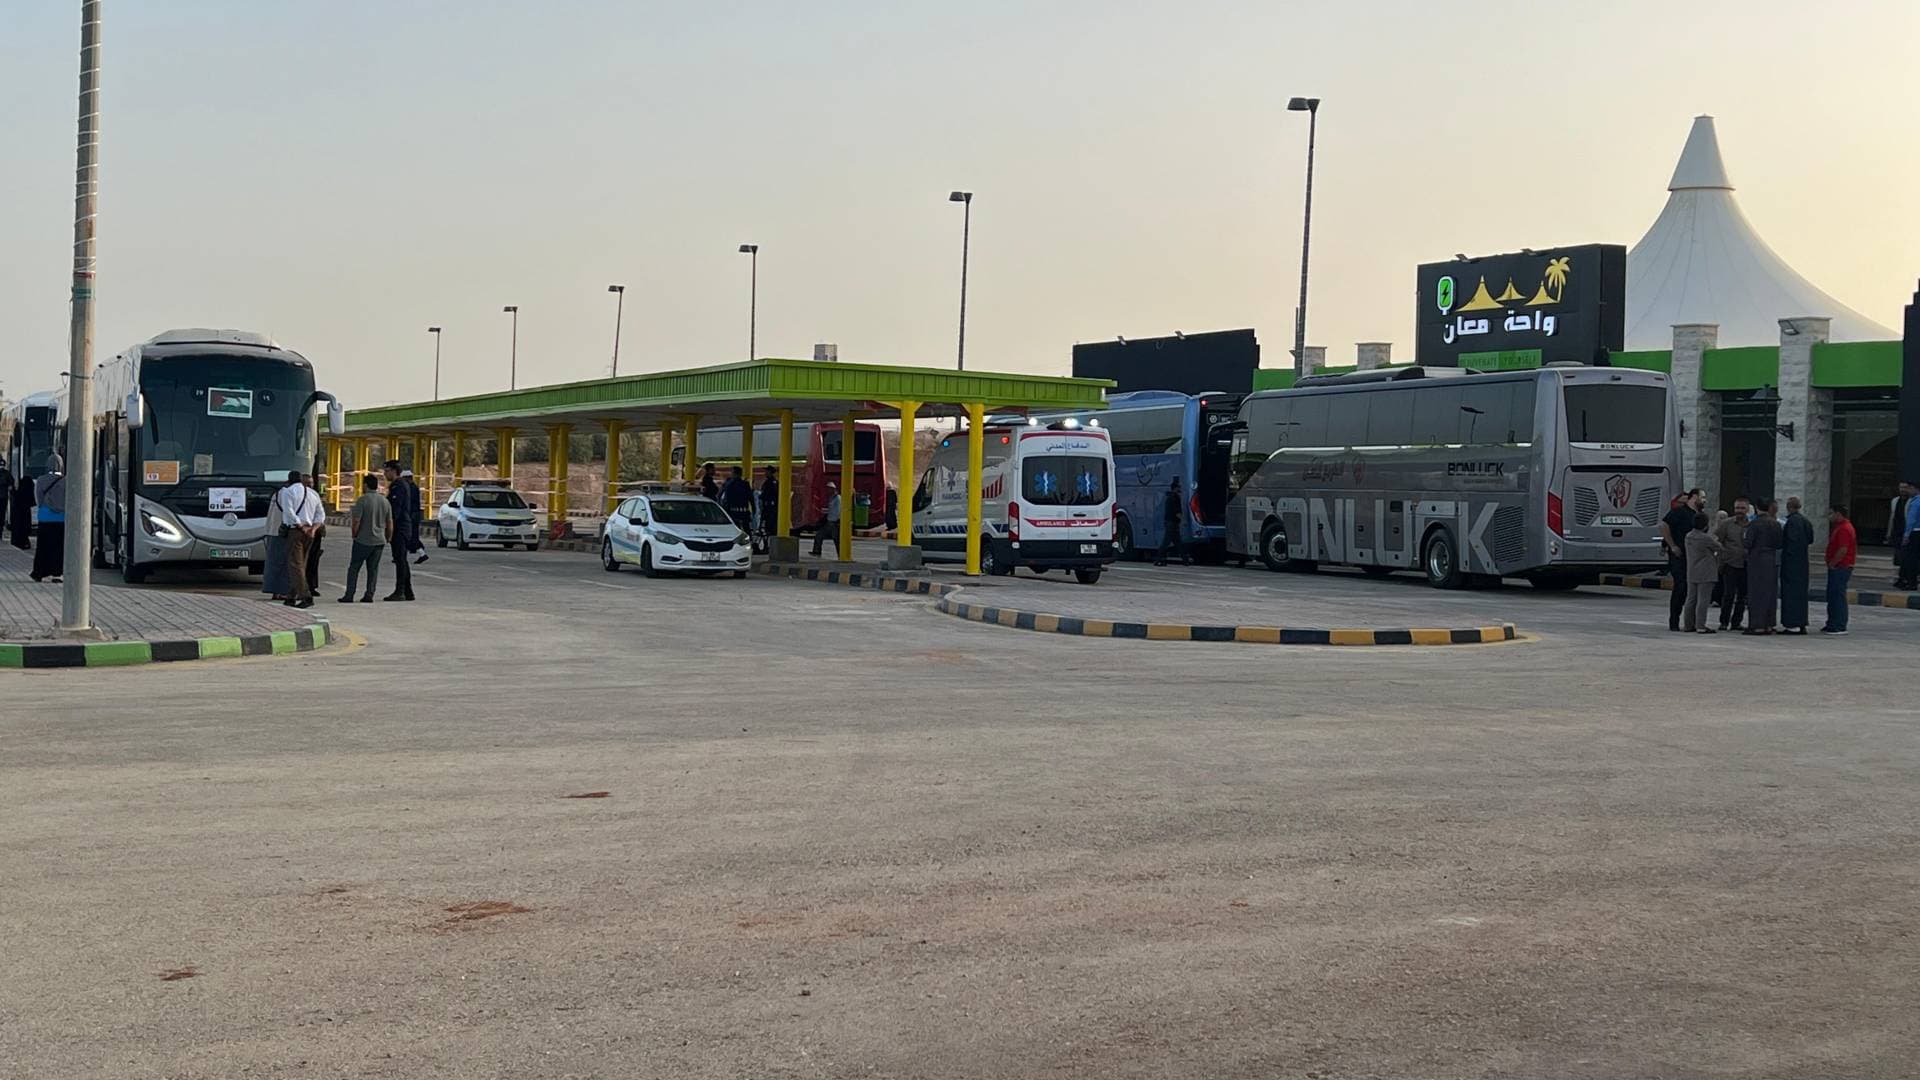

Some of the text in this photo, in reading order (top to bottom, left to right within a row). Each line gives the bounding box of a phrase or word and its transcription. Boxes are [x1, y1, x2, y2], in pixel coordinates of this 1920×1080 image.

[1444, 310, 1555, 344] واحة معان
[1447, 462, 1504, 477] BONLUCK
